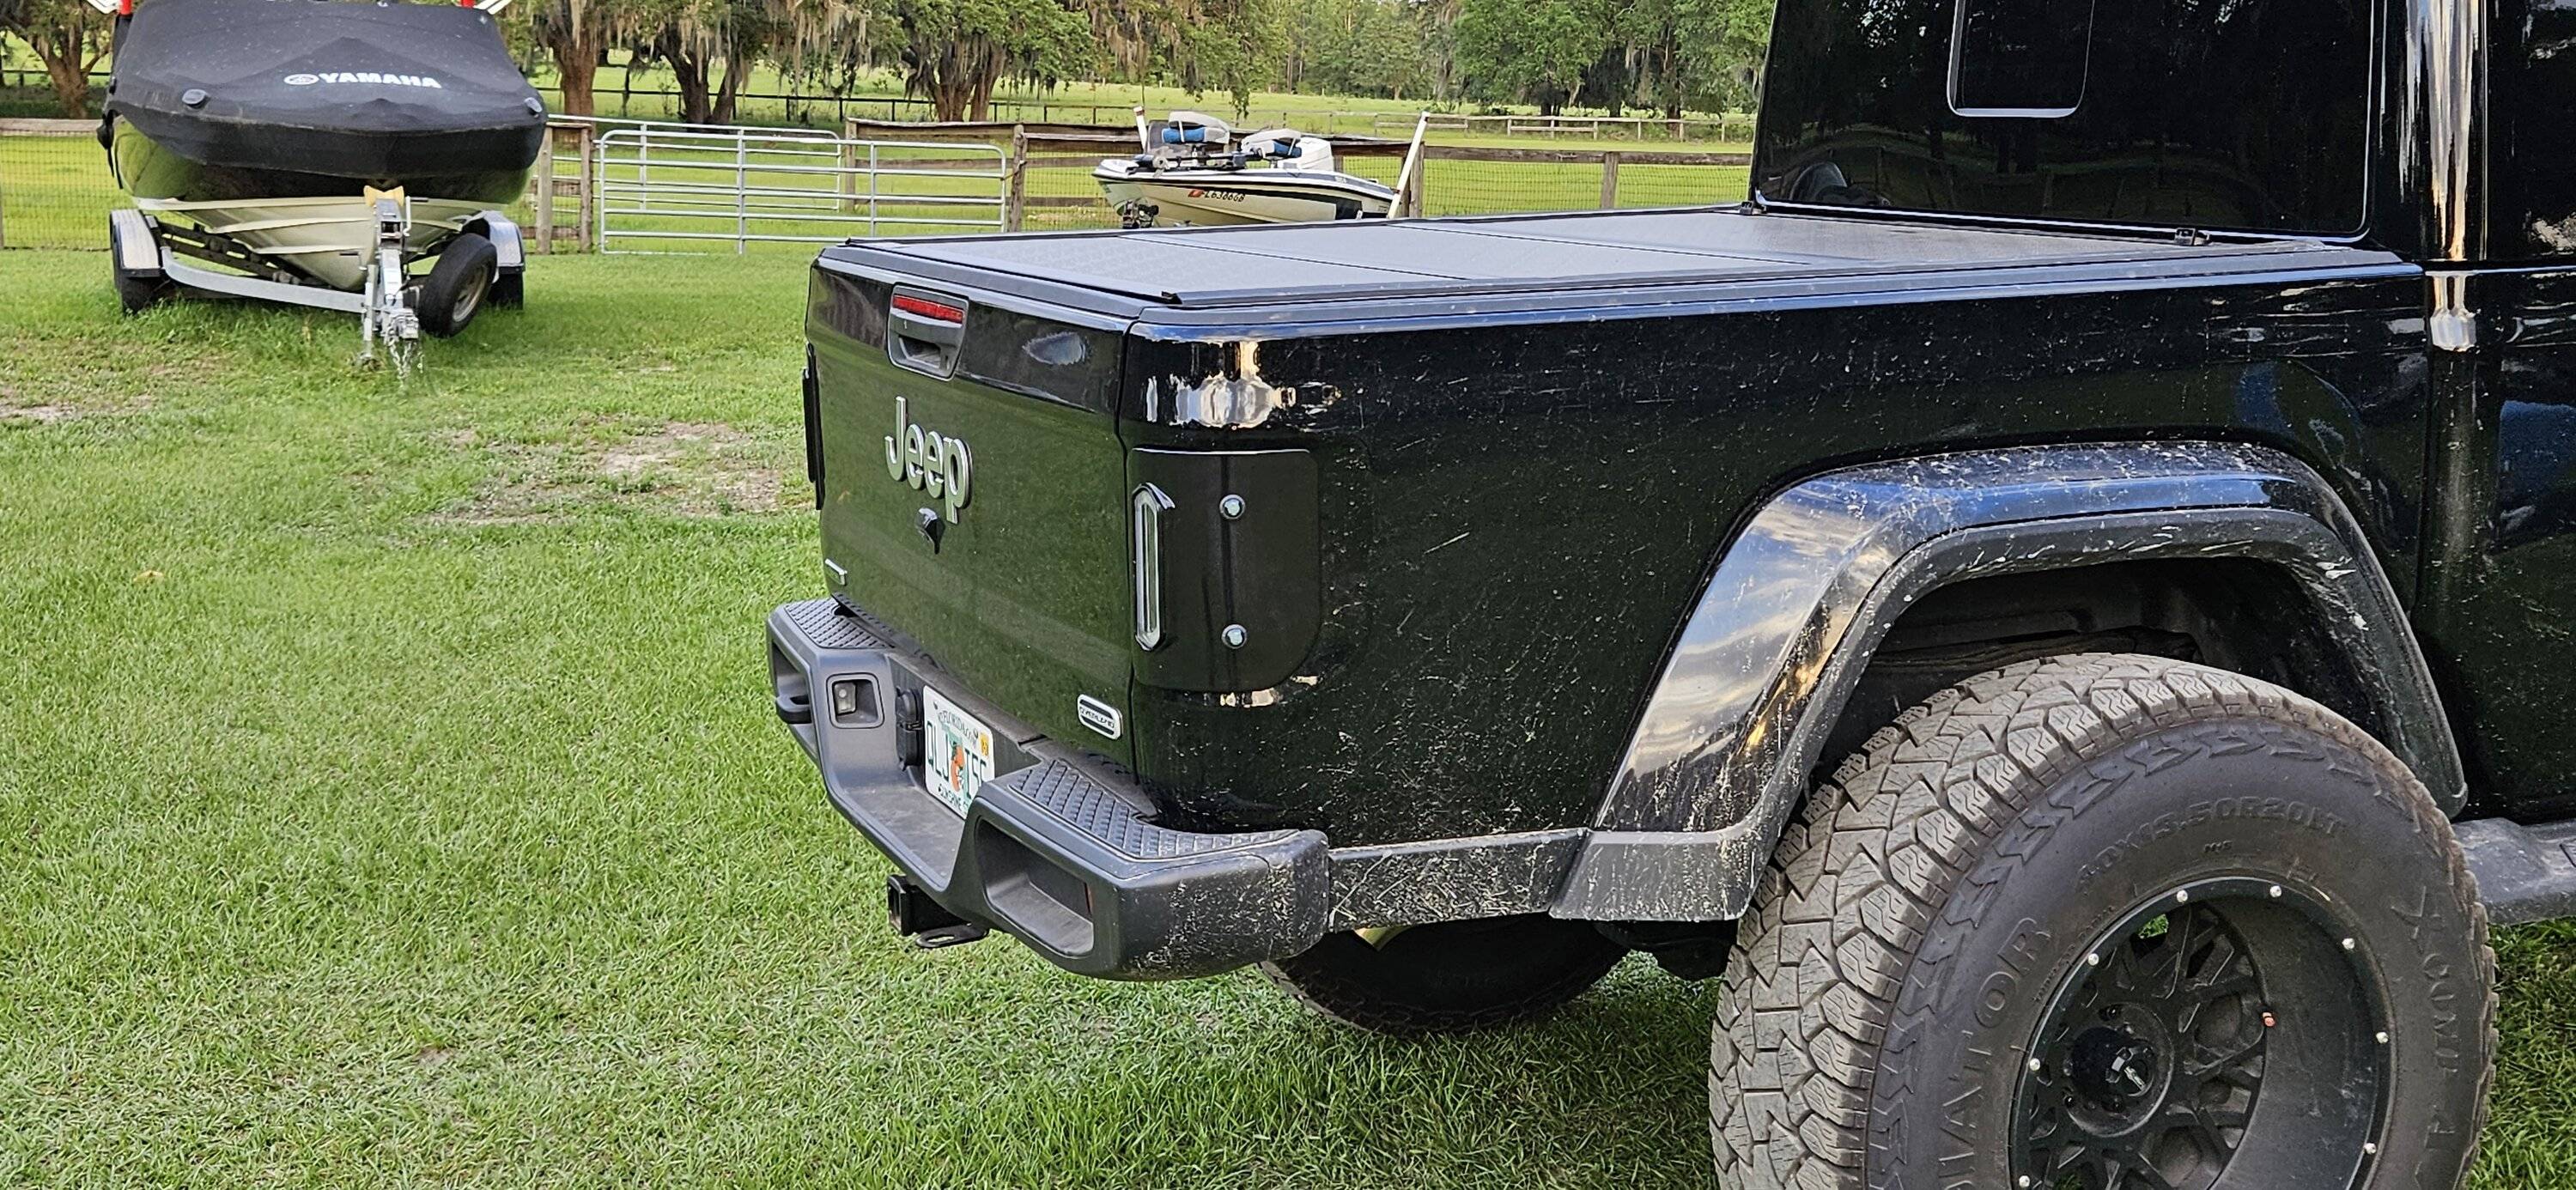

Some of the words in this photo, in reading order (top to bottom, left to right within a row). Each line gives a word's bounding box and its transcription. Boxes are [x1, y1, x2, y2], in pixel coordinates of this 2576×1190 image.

[319, 72, 442, 89] YAMAHA
[884, 396, 972, 525] Jeep
[927, 720, 950, 783] QLJ
